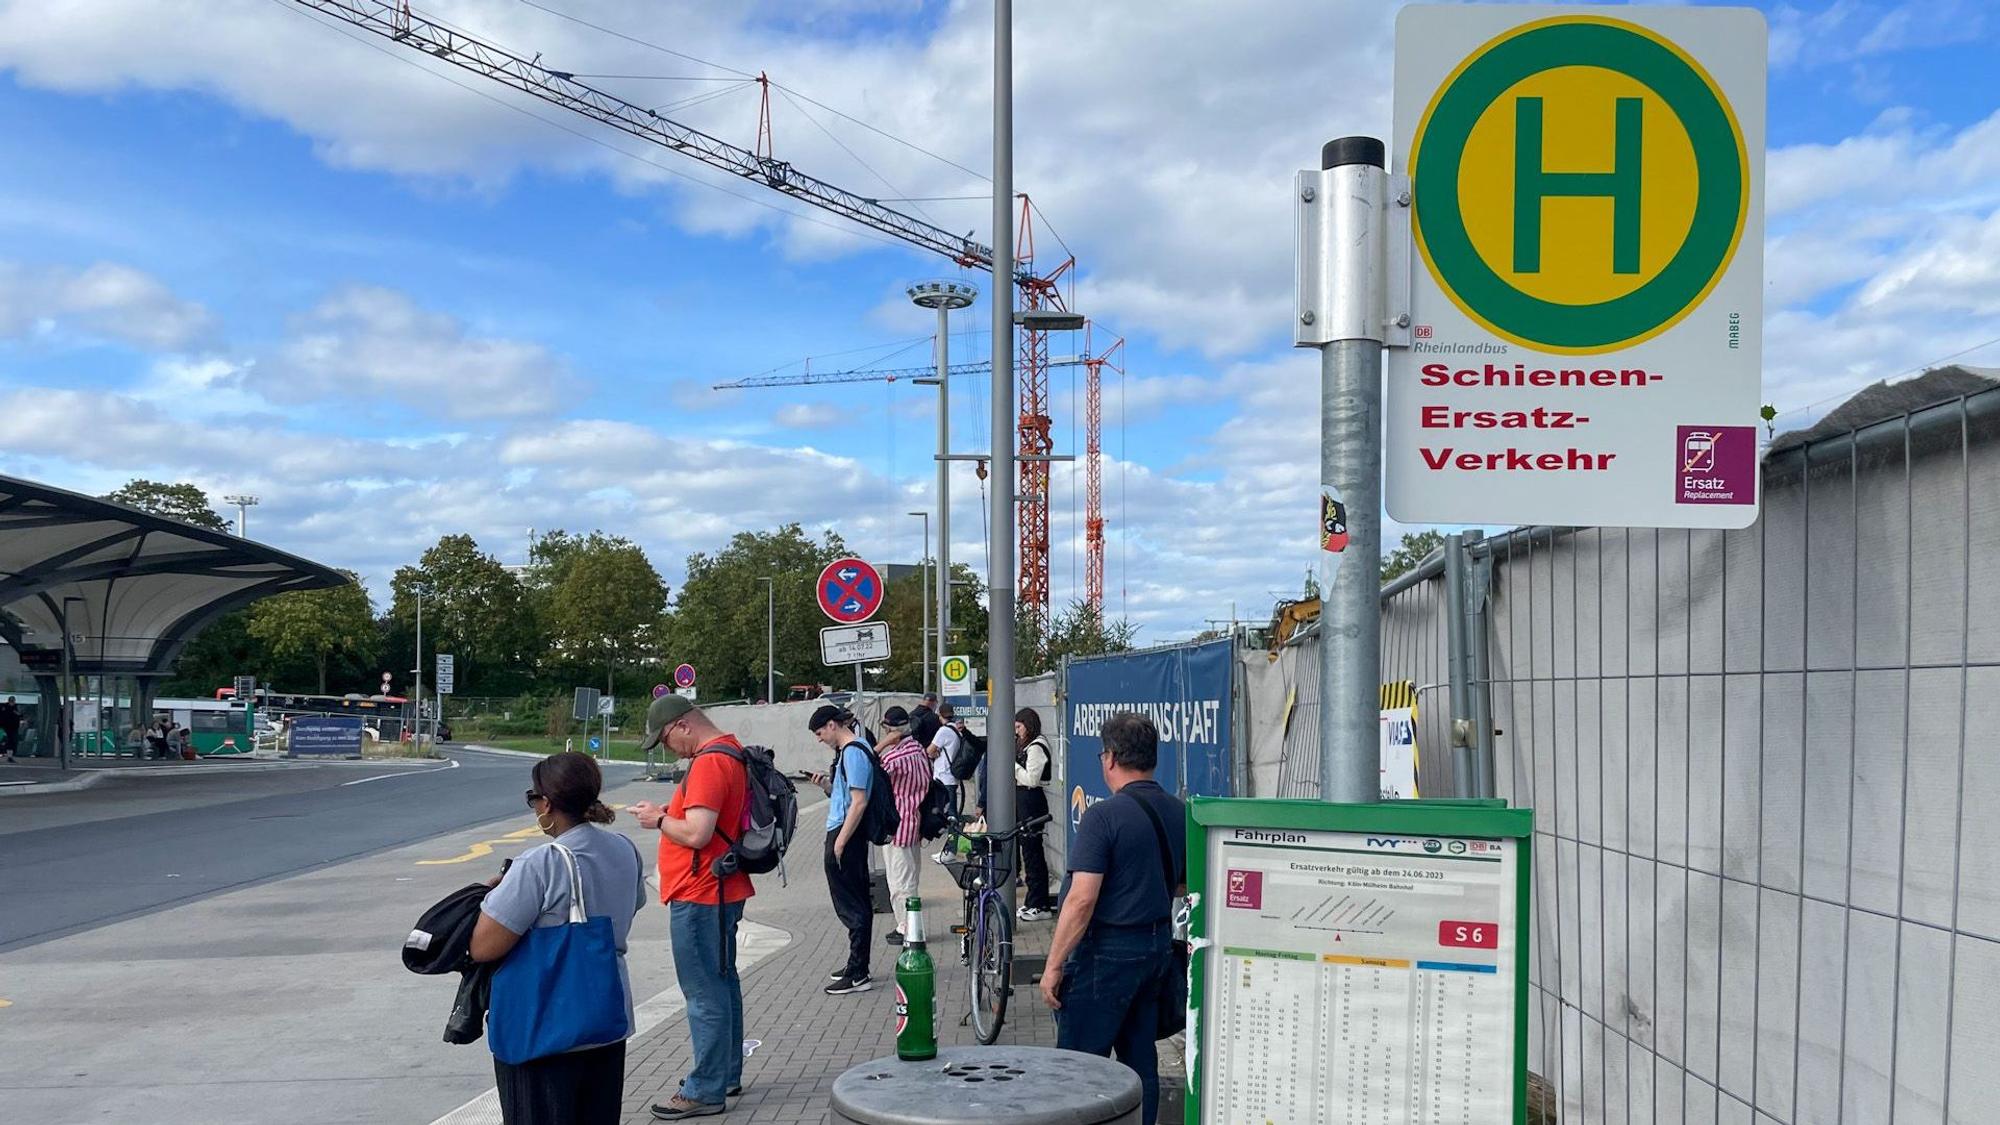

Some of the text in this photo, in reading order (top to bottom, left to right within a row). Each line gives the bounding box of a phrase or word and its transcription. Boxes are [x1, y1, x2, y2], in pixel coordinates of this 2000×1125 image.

[1513, 97, 1643, 274] H
[1416, 327, 1431, 337] DB
[1729, 312, 1740, 349] MABEG
[1413, 341, 1508, 355] Rheinlandbus
[1420, 363, 1664, 387] Schienen-
[1421, 406, 1590, 429] Ersatz-
[1419, 448, 1616, 470] Verkehr
[1684, 476, 1725, 489] Ersatz
[1683, 490, 1734, 500] Replacement
[950, 662, 961, 677] H
[1073, 700, 1220, 745] ARBEITNSCHAFT
[1234, 829, 1307, 844] Fahrplan
[1290, 862, 1444, 880] Ersatzverkehr gültig ab dem 24.06.2023
[1229, 893, 1249, 902] Ersatz
[1455, 926, 1483, 943] S 6
